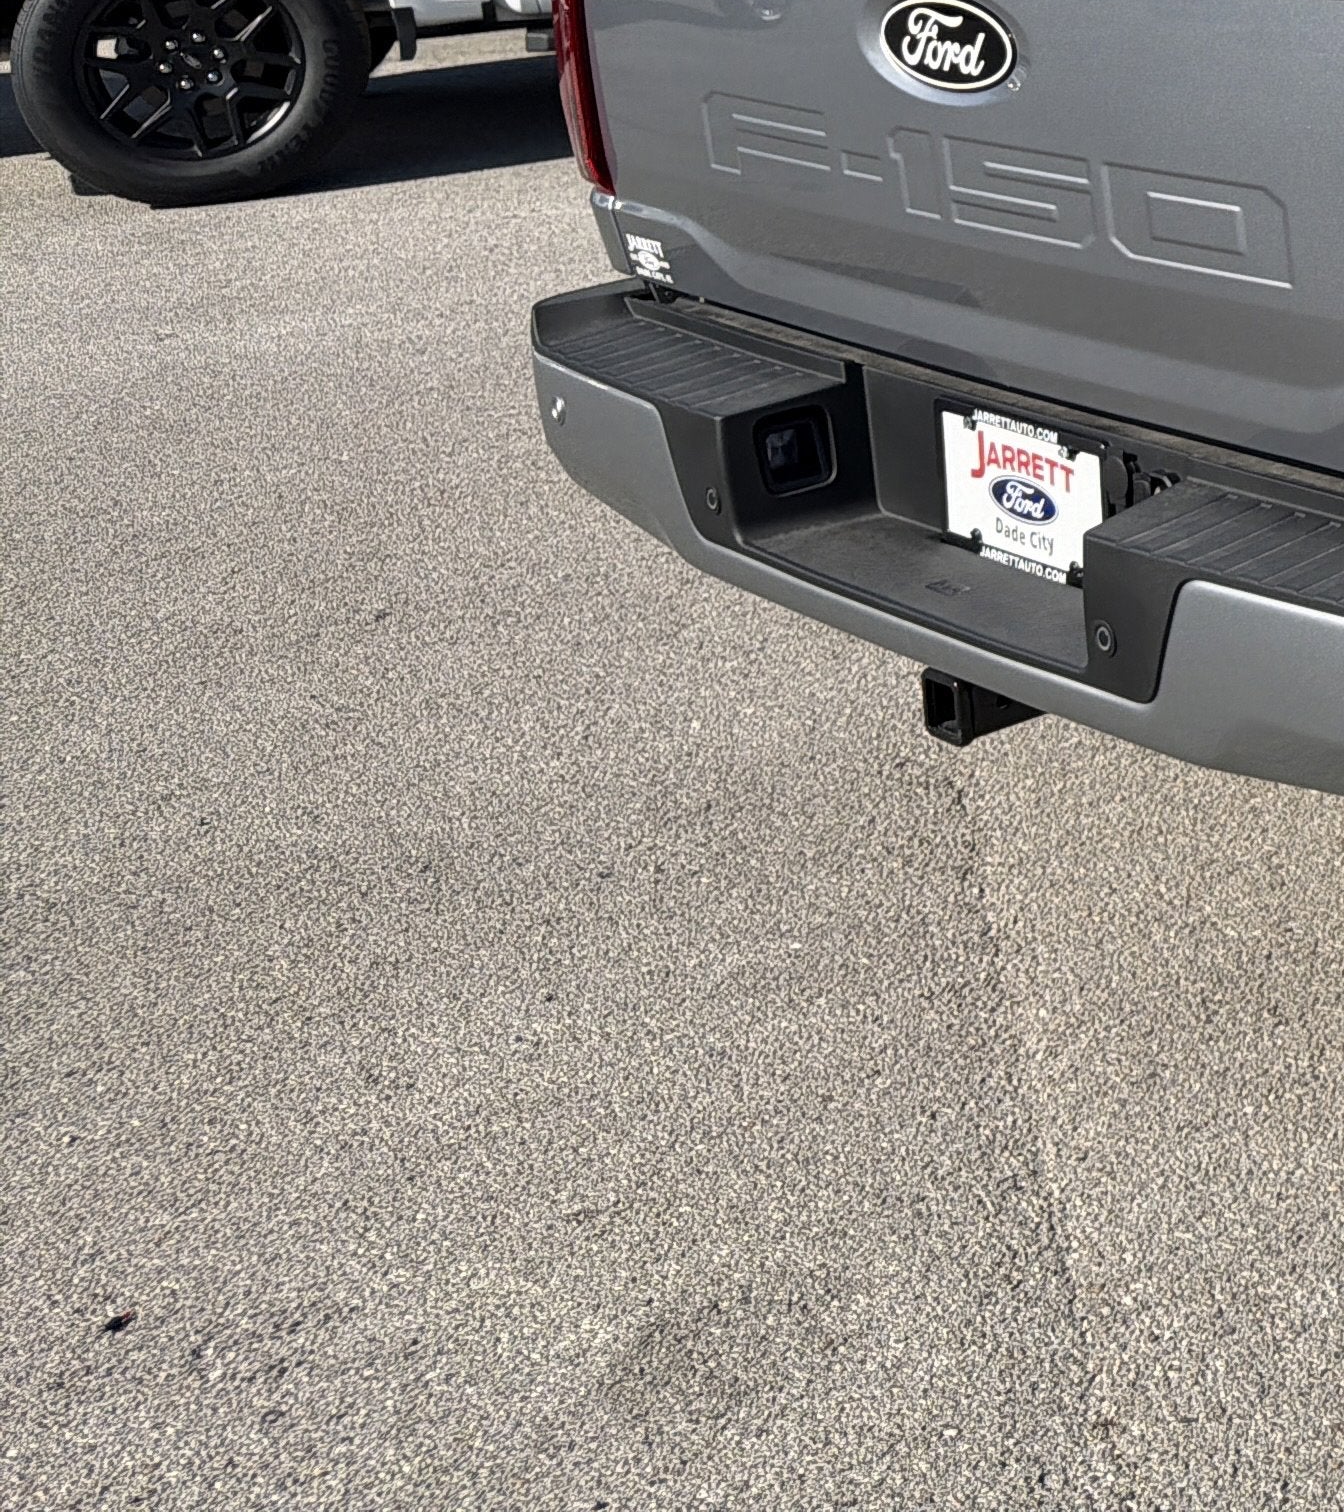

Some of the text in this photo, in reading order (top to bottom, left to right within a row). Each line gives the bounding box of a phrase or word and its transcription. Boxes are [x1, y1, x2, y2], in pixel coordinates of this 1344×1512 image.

[901, 7, 986, 77] Ford
[703, 90, 1294, 289] F-150
[972, 408, 1059, 444] JARRETTAUTO.COM
[971, 430, 1075, 493] JARRETT
[1002, 481, 1045, 519] Ford
[995, 517, 1055, 556] Dade City
[980, 545, 1067, 585] JARRETTAUTO.COM
